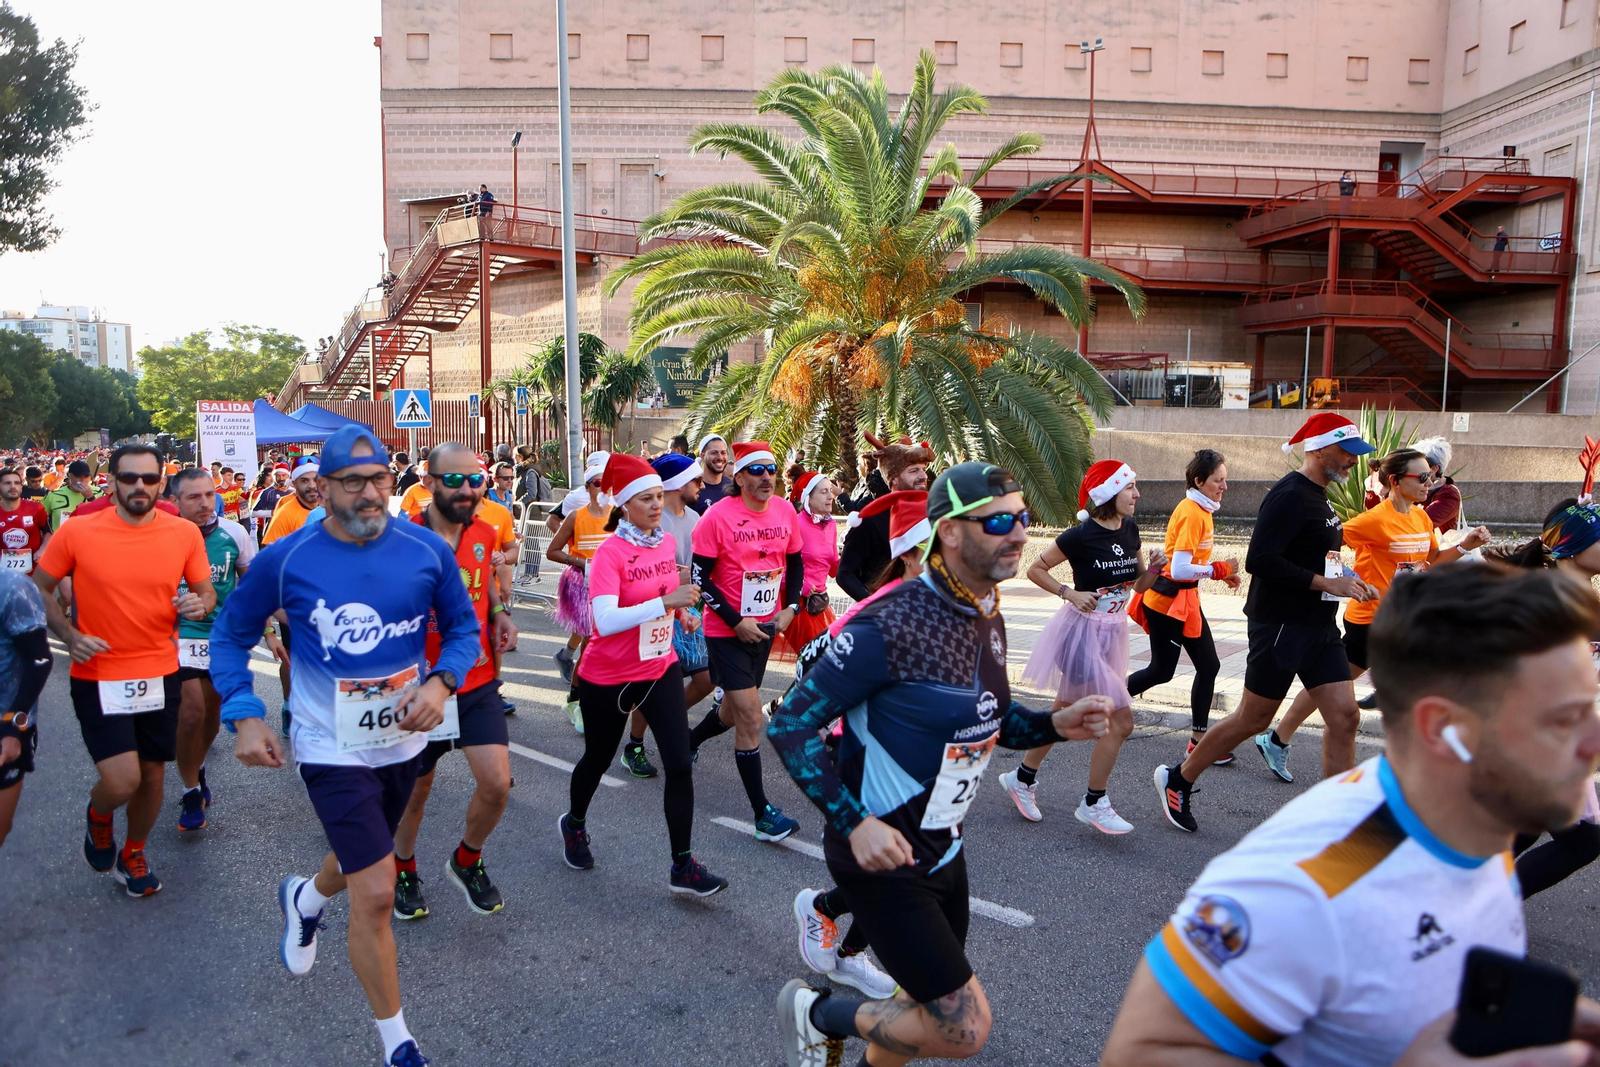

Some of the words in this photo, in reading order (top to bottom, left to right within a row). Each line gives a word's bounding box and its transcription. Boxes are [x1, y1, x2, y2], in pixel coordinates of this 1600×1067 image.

[662, 359, 681, 369] Gran
[201, 402, 252, 412] SALIDA
[204, 414, 220, 423] XII
[733, 529, 756, 543] DONA
[757, 526, 789, 541] MEDULA
[6, 559, 26, 568] 272
[628, 563, 655, 582] DONA
[655, 558, 676, 579] MEDU
[1111, 567, 1135, 576] SALSERAS
[753, 587, 776, 605] 401
[337, 614, 426, 645] runners
[650, 625, 671, 644] 595
[124, 680, 148, 699] 59
